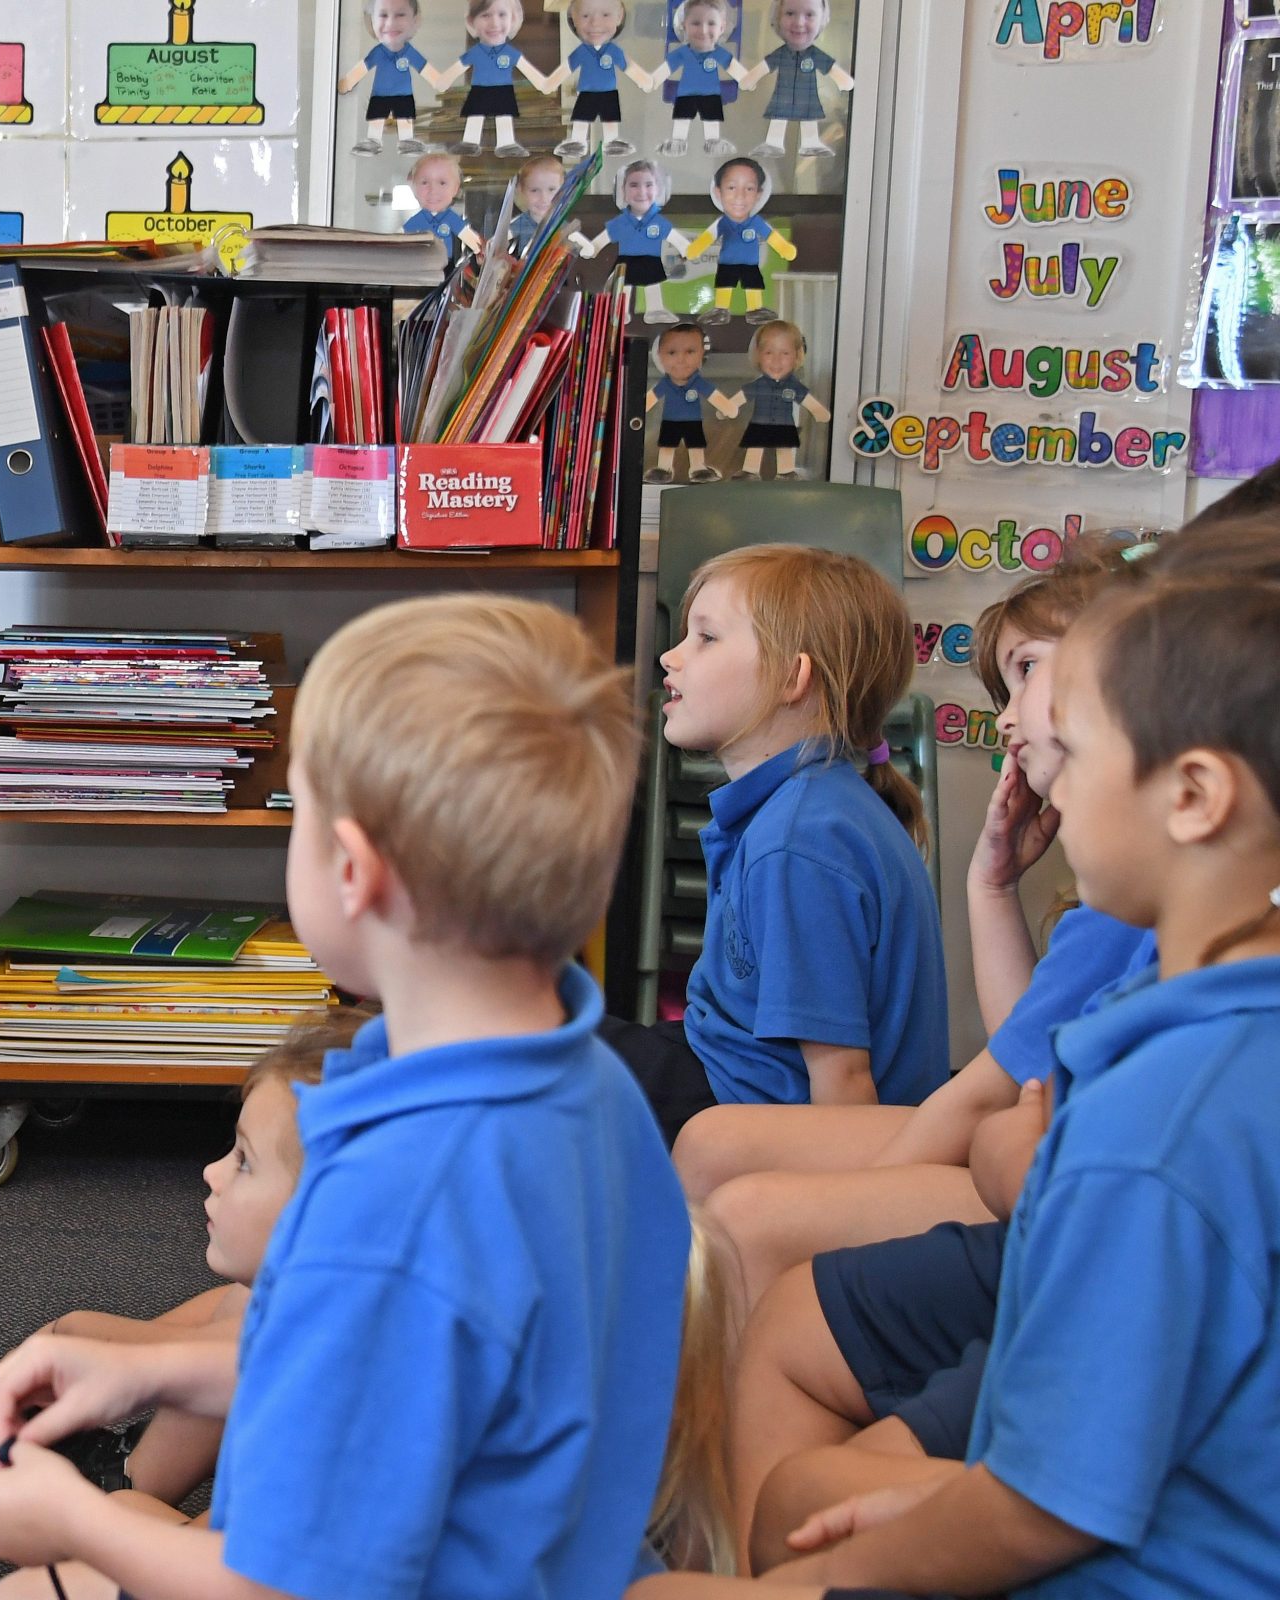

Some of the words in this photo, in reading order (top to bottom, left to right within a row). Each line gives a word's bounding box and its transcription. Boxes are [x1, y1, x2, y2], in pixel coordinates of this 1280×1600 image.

[996, 0, 1156, 59] April
[147, 49, 219, 65] August
[116, 73, 148, 86] Bobby
[1256, 81, 1273, 91] This
[115, 87, 150, 99] Trinity
[192, 86, 217, 95] Katie
[985, 170, 1129, 225] June
[144, 217, 216, 232] October
[990, 244, 1119, 306] July
[944, 335, 1159, 397] August
[853, 401, 1186, 469] September
[418, 472, 512, 493] Reading
[427, 491, 518, 512] Mastery
